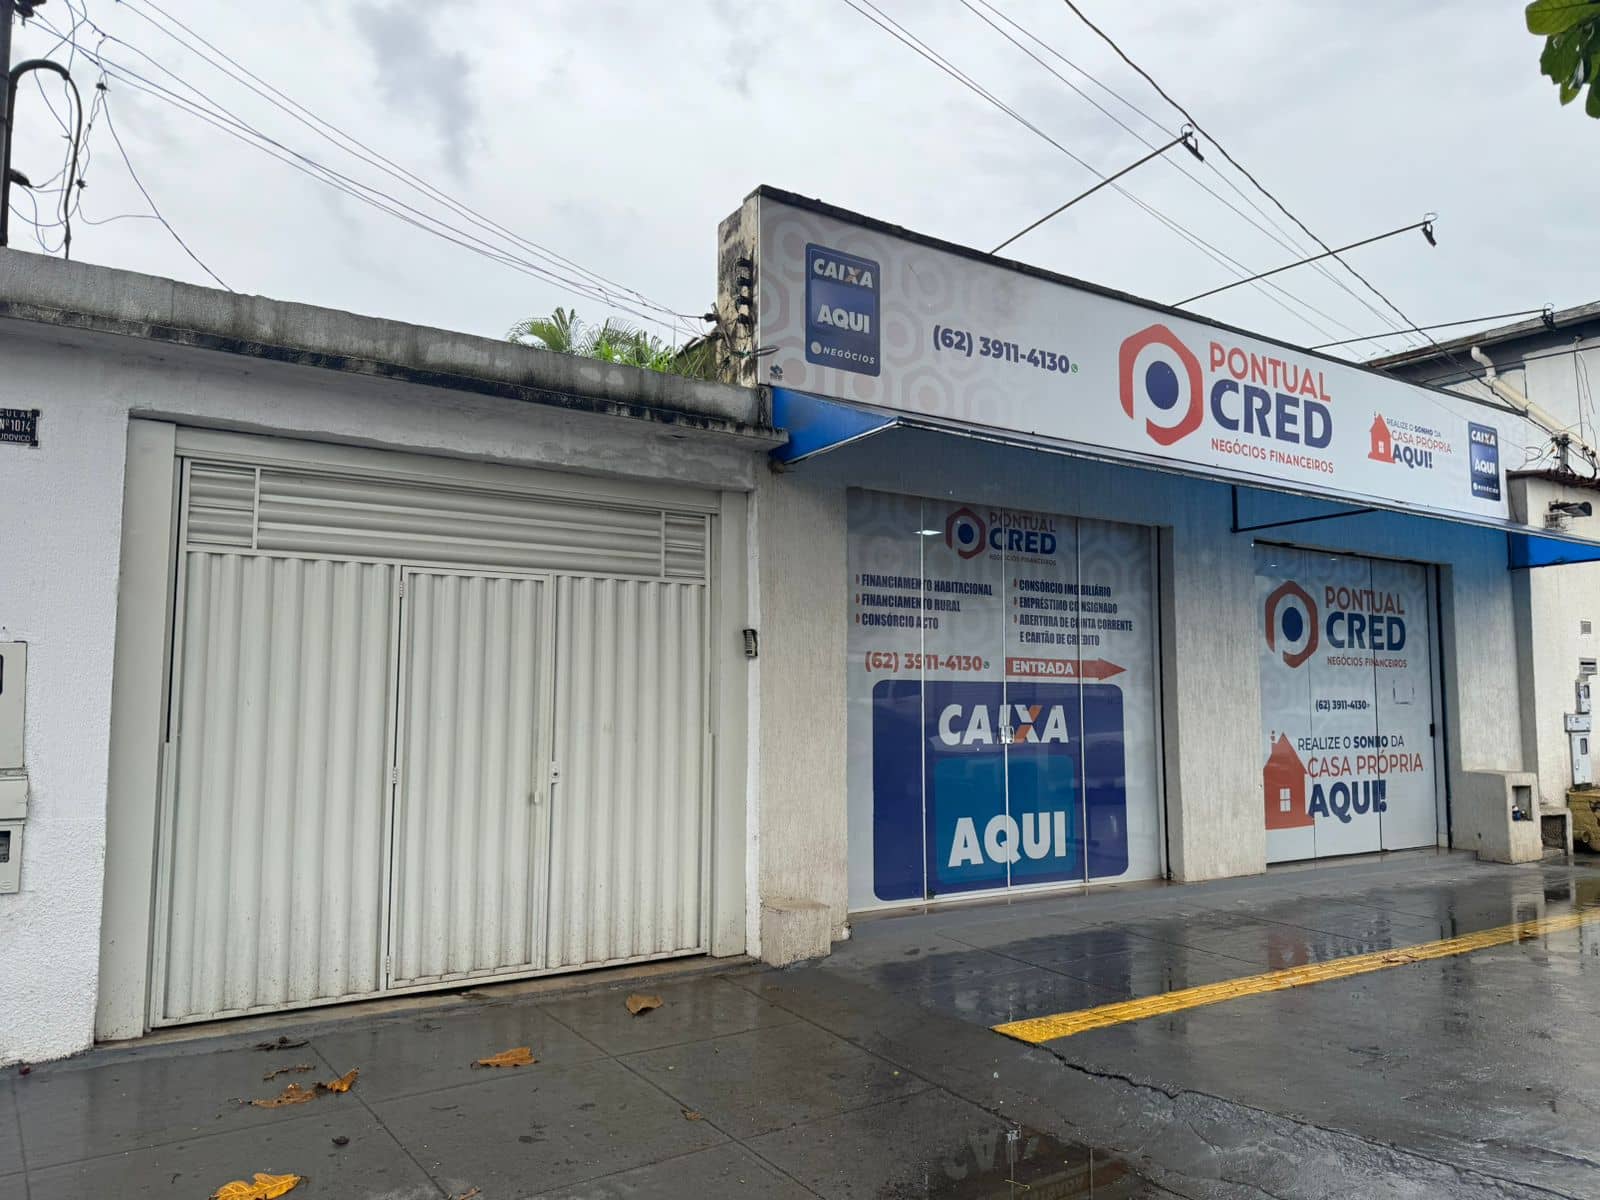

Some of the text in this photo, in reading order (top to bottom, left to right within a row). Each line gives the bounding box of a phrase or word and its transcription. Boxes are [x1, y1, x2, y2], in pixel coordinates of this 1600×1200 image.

[813, 258, 874, 289] CAIXA
[817, 303, 870, 334] AQUI
[823, 346, 875, 365] NEGÓCIOS
[933, 324, 1070, 374] (62) 3911-4130
[1210, 341, 1332, 402] PONTUAL
[1210, 378, 1333, 449] CRED
[1391, 430, 1415, 446] CASA
[1471, 430, 1496, 446] CAIXA
[1211, 438, 1334, 474] NEGÓCIOS FINANCEIROS
[1393, 443, 1433, 469] AQUI!
[1474, 459, 1495, 475] AQUI
[989, 511, 1057, 533] PONTUAL
[989, 528, 1057, 555] CRED
[861, 573, 993, 596] FINANCIAMENTO HABITACIONAL
[1019, 578, 1062, 595] CONSÓRCIO
[861, 593, 961, 613] FINANCIAMENTO RURAL
[1019, 596, 1068, 612] EMPRÉSTIMO
[1325, 585, 1405, 615] PONTUAL
[861, 612, 914, 629] CONSÓRCIO
[1019, 614, 1059, 627] ABERTURA
[1060, 617, 1069, 628] DE
[1098, 619, 1133, 632] CORRENTE
[1325, 611, 1407, 651] CRED
[1020, 631, 1025, 642] E
[1056, 633, 1065, 645] DE
[865, 651, 983, 673] (62) 3911-4130
[1012, 659, 1075, 675] ENTRADA
[1327, 654, 1408, 668] NEGÓCIOS FINANCEIROS
[1315, 699, 1367, 712] (62) 3911-4130
[938, 703, 1069, 746] CAIXA
[1297, 734, 1405, 751] REALIZE O SONHO DA
[1307, 749, 1424, 778] CASA PRÓPRIA
[1307, 780, 1387, 824] AQUI!
[947, 811, 1067, 867] AQUI
